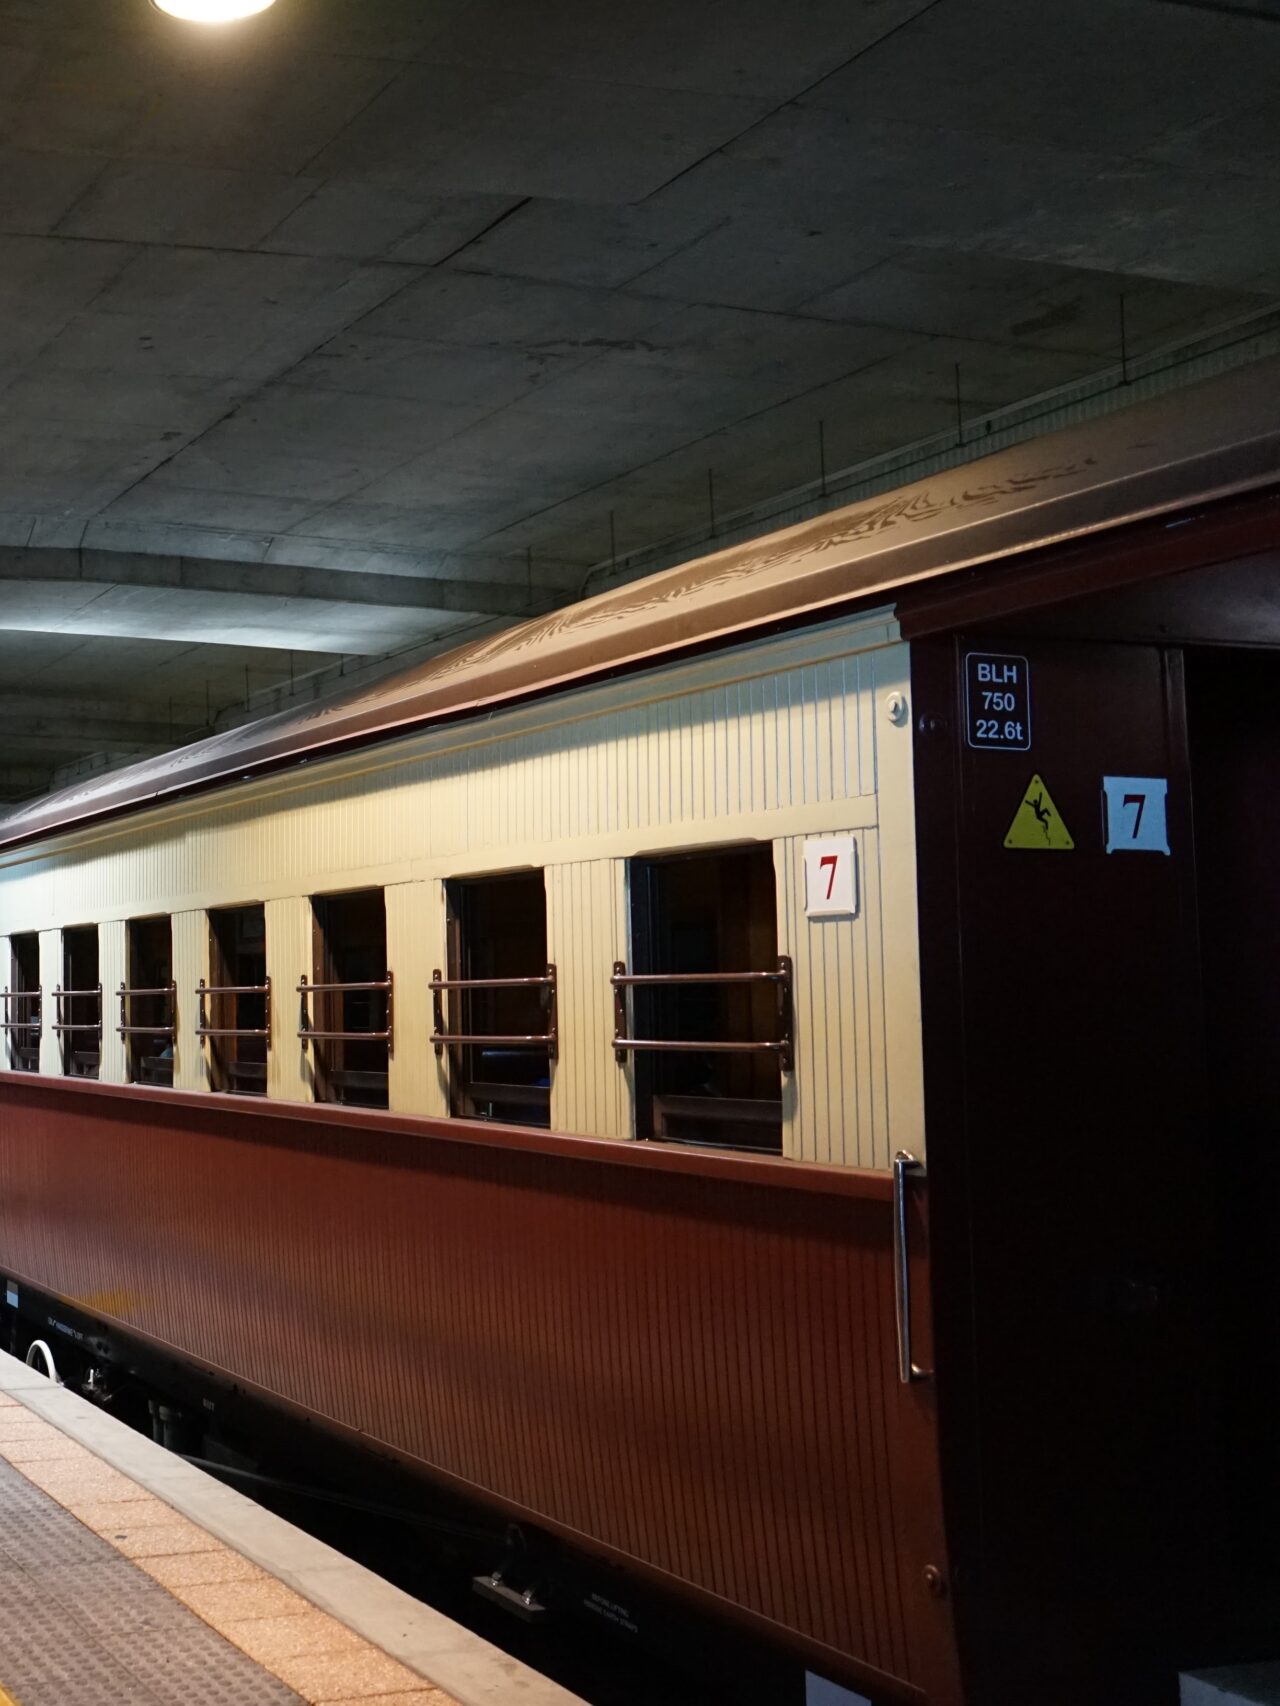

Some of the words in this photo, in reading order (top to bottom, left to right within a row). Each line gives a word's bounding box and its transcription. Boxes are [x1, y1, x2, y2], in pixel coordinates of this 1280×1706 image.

[977, 663, 1017, 684] BLH
[981, 691, 1015, 712] 750
[975, 719, 1023, 741] 22.6t
[1123, 793, 1146, 839] 7
[820, 855, 838, 900] 7
